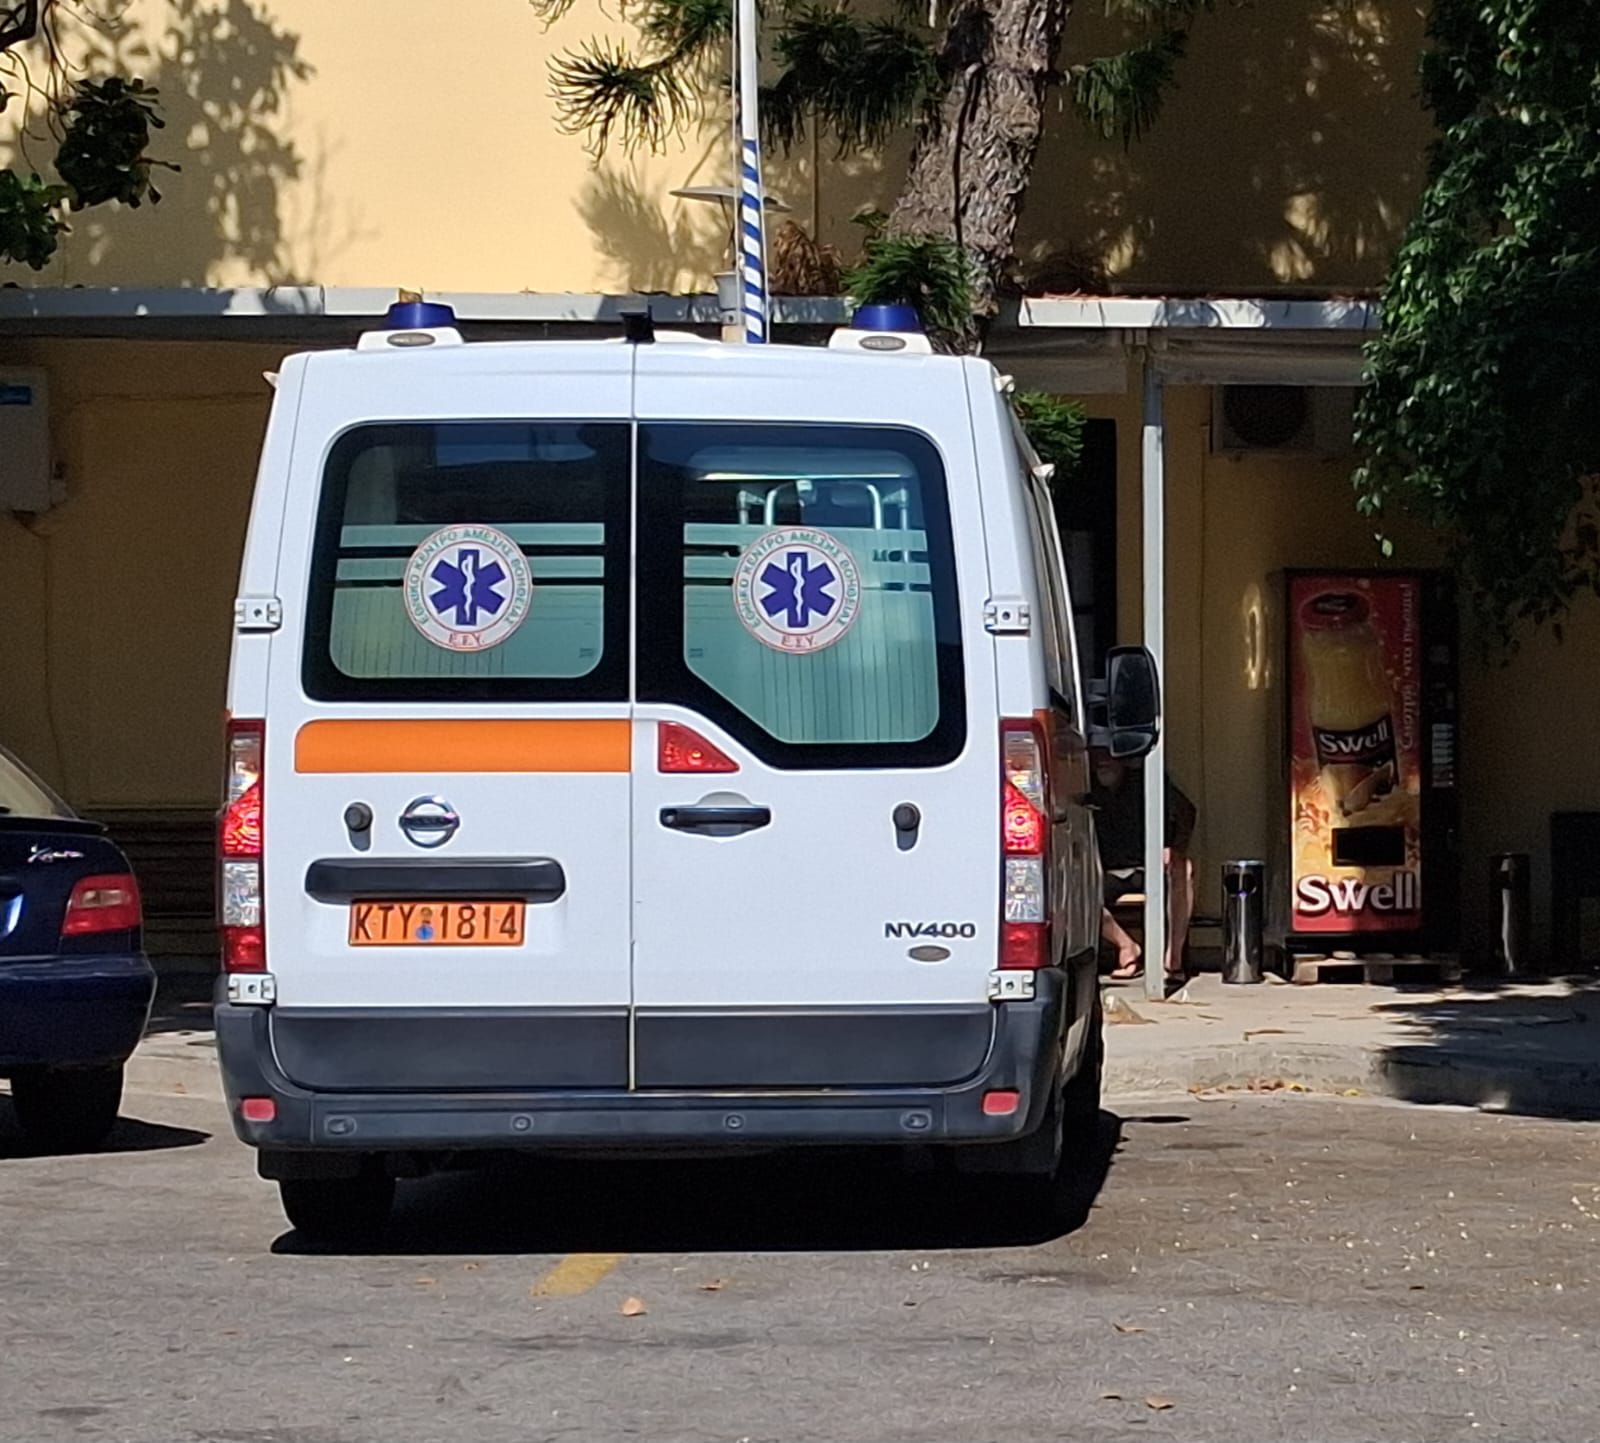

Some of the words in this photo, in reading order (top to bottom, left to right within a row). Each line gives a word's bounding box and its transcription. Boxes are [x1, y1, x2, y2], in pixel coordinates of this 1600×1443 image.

[1318, 719, 1388, 755] Swell
[1297, 872, 1414, 913] Swell
[354, 905, 417, 940] KTY
[439, 905, 517, 940] 1814
[885, 922, 976, 938] NV400
